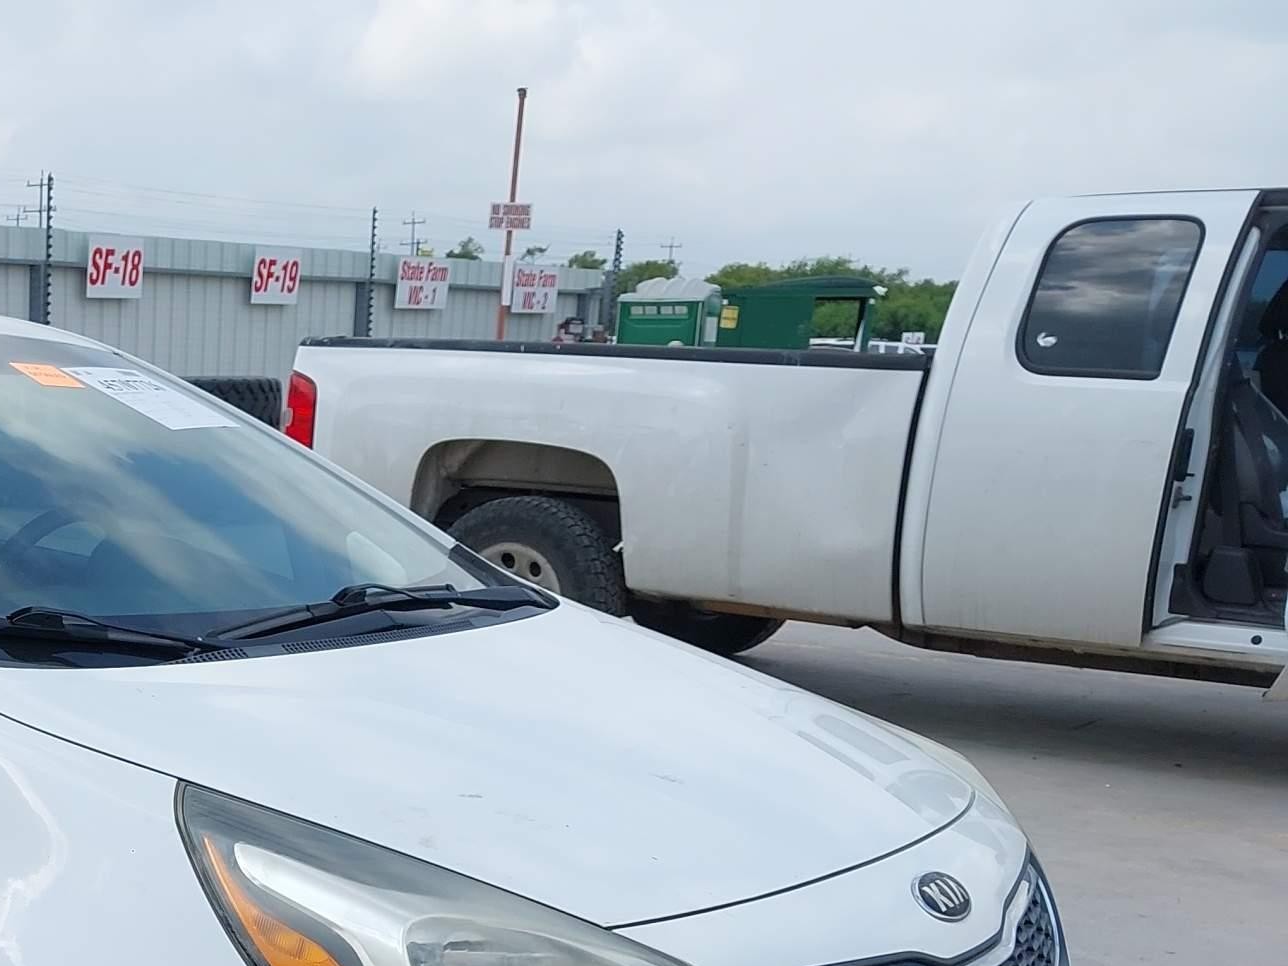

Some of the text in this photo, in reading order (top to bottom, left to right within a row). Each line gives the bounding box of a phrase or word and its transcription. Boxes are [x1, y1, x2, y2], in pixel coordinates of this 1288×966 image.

[88, 247, 142, 286] SF-18
[253, 258, 300, 294] SF-19
[401, 260, 449, 282] State Farm
[516, 268, 557, 289] State Farm
[921, 877, 969, 912] KIA
